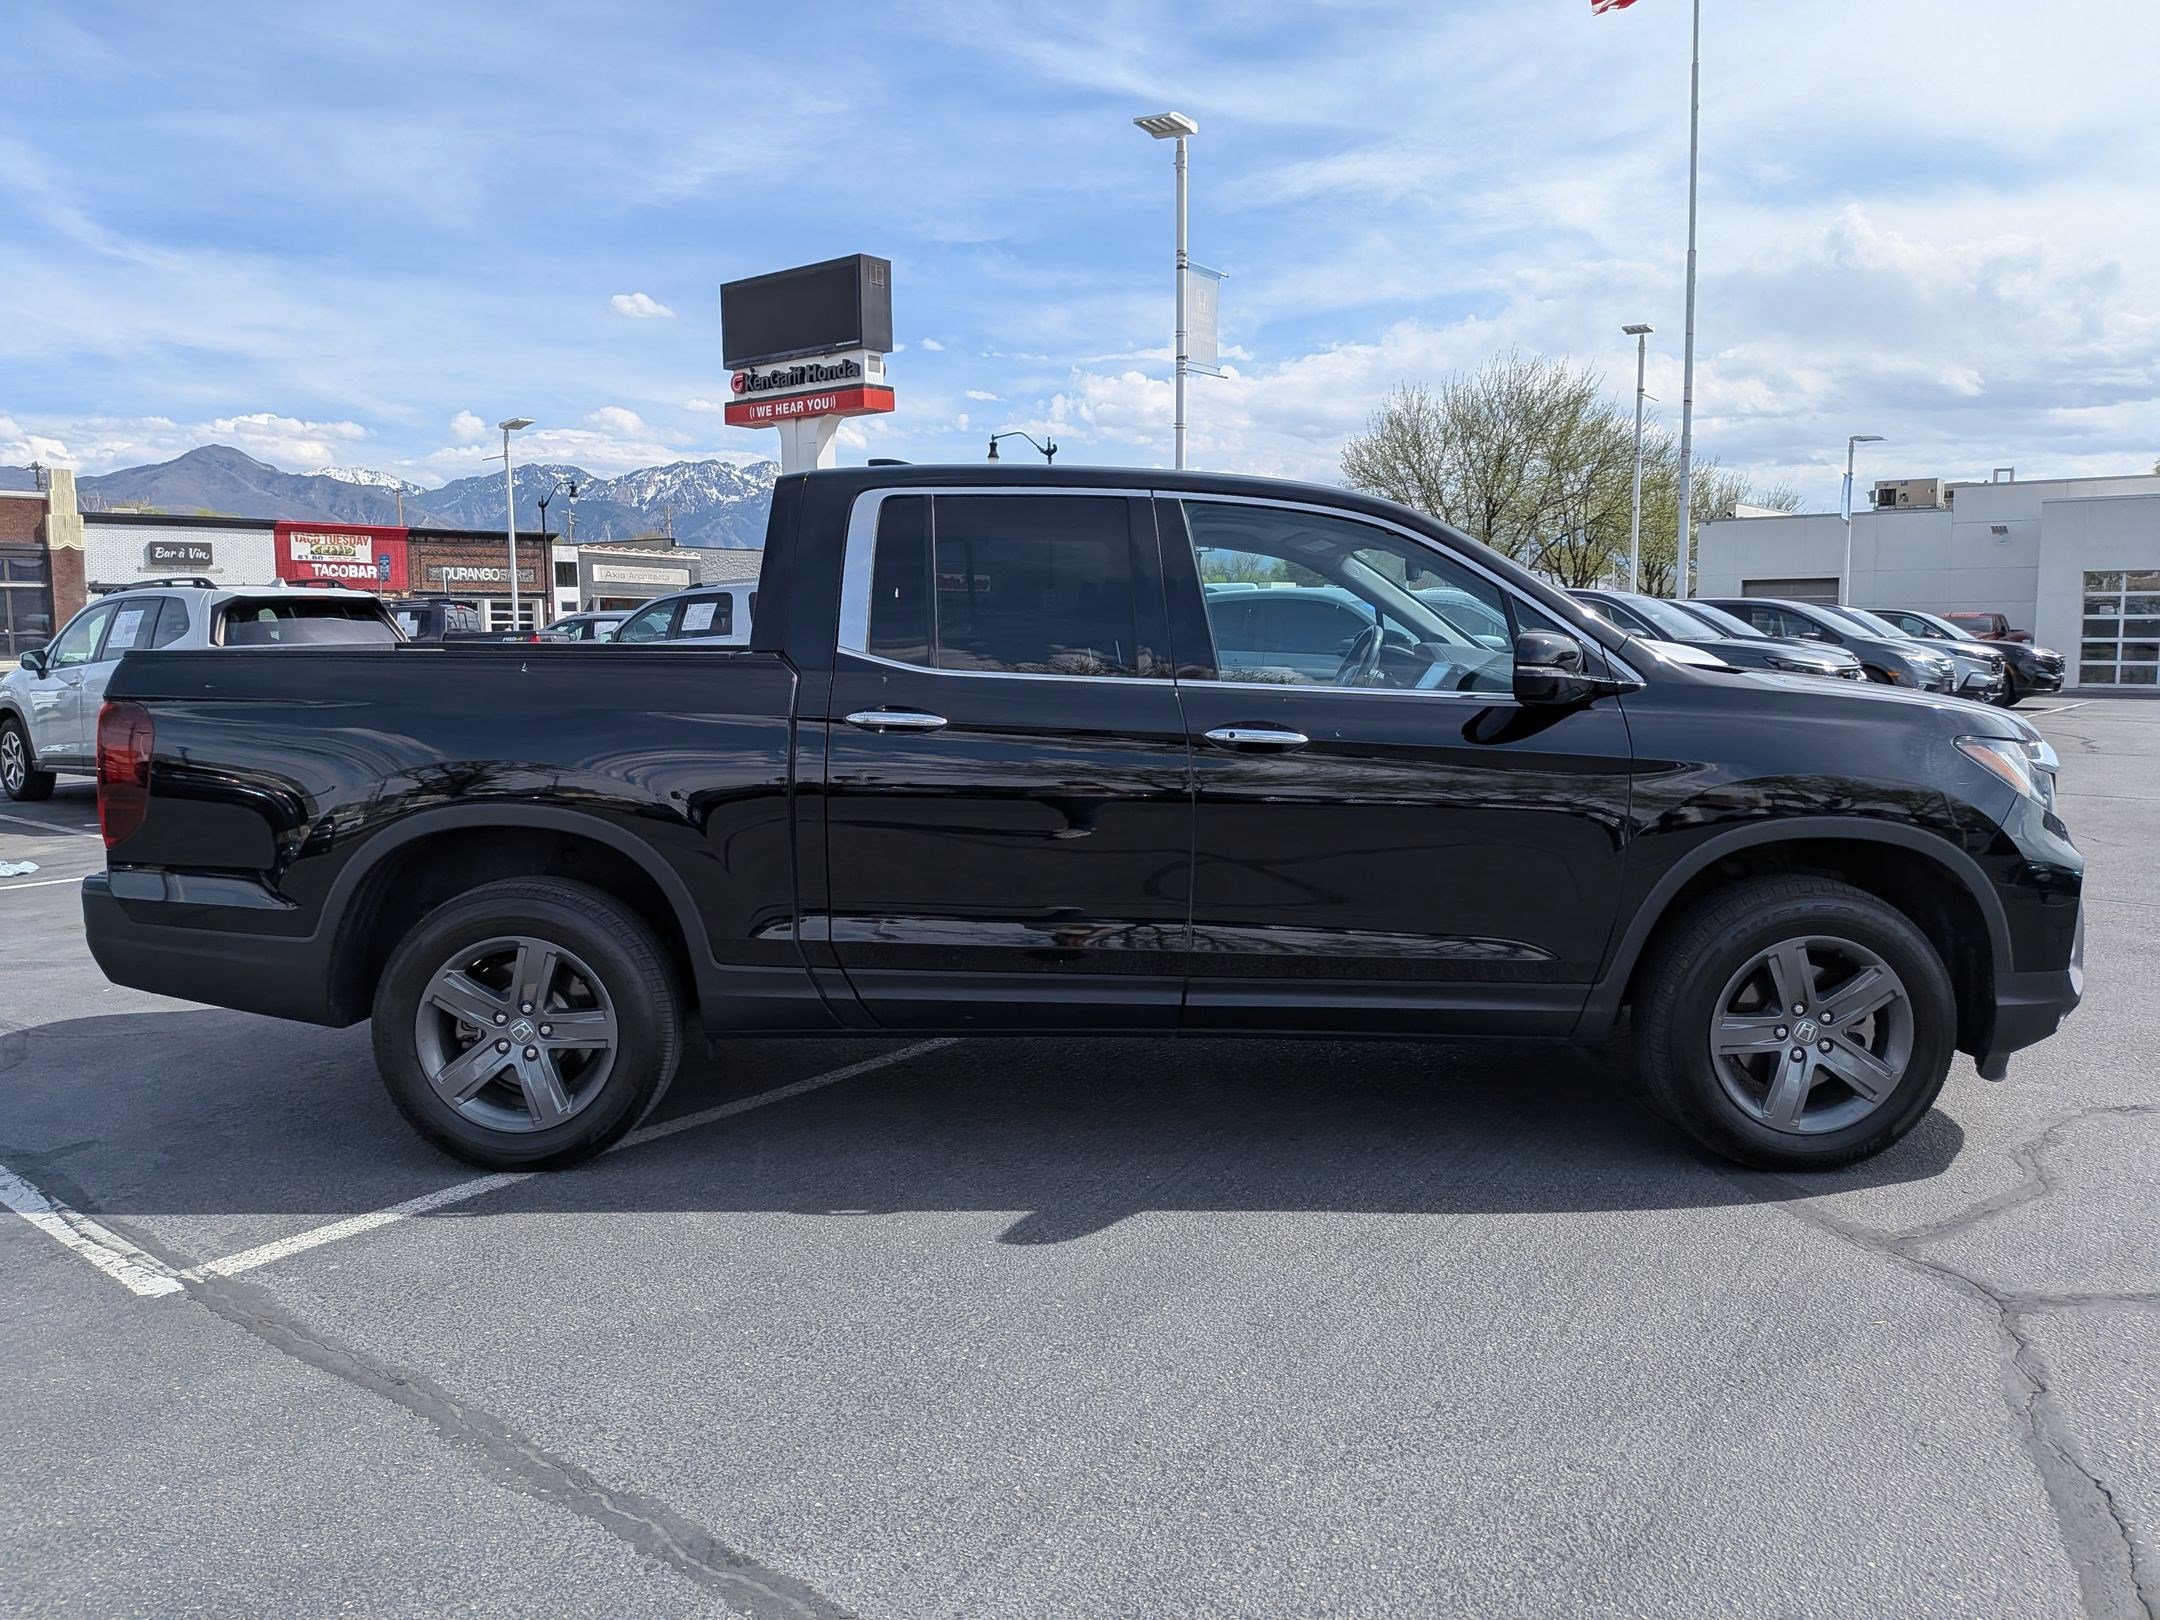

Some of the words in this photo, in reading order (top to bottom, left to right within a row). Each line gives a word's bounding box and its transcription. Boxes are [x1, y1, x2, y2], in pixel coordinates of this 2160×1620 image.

[805, 359, 860, 384] Honda
[756, 406, 772, 418] WE
[775, 402, 804, 415] HEAR
[807, 398, 829, 411] YOU
[294, 533, 320, 544] TACO
[324, 535, 369, 546] TUESDAY
[155, 546, 177, 559] Bar
[178, 547, 186, 559] à
[188, 547, 210, 560] Vin
